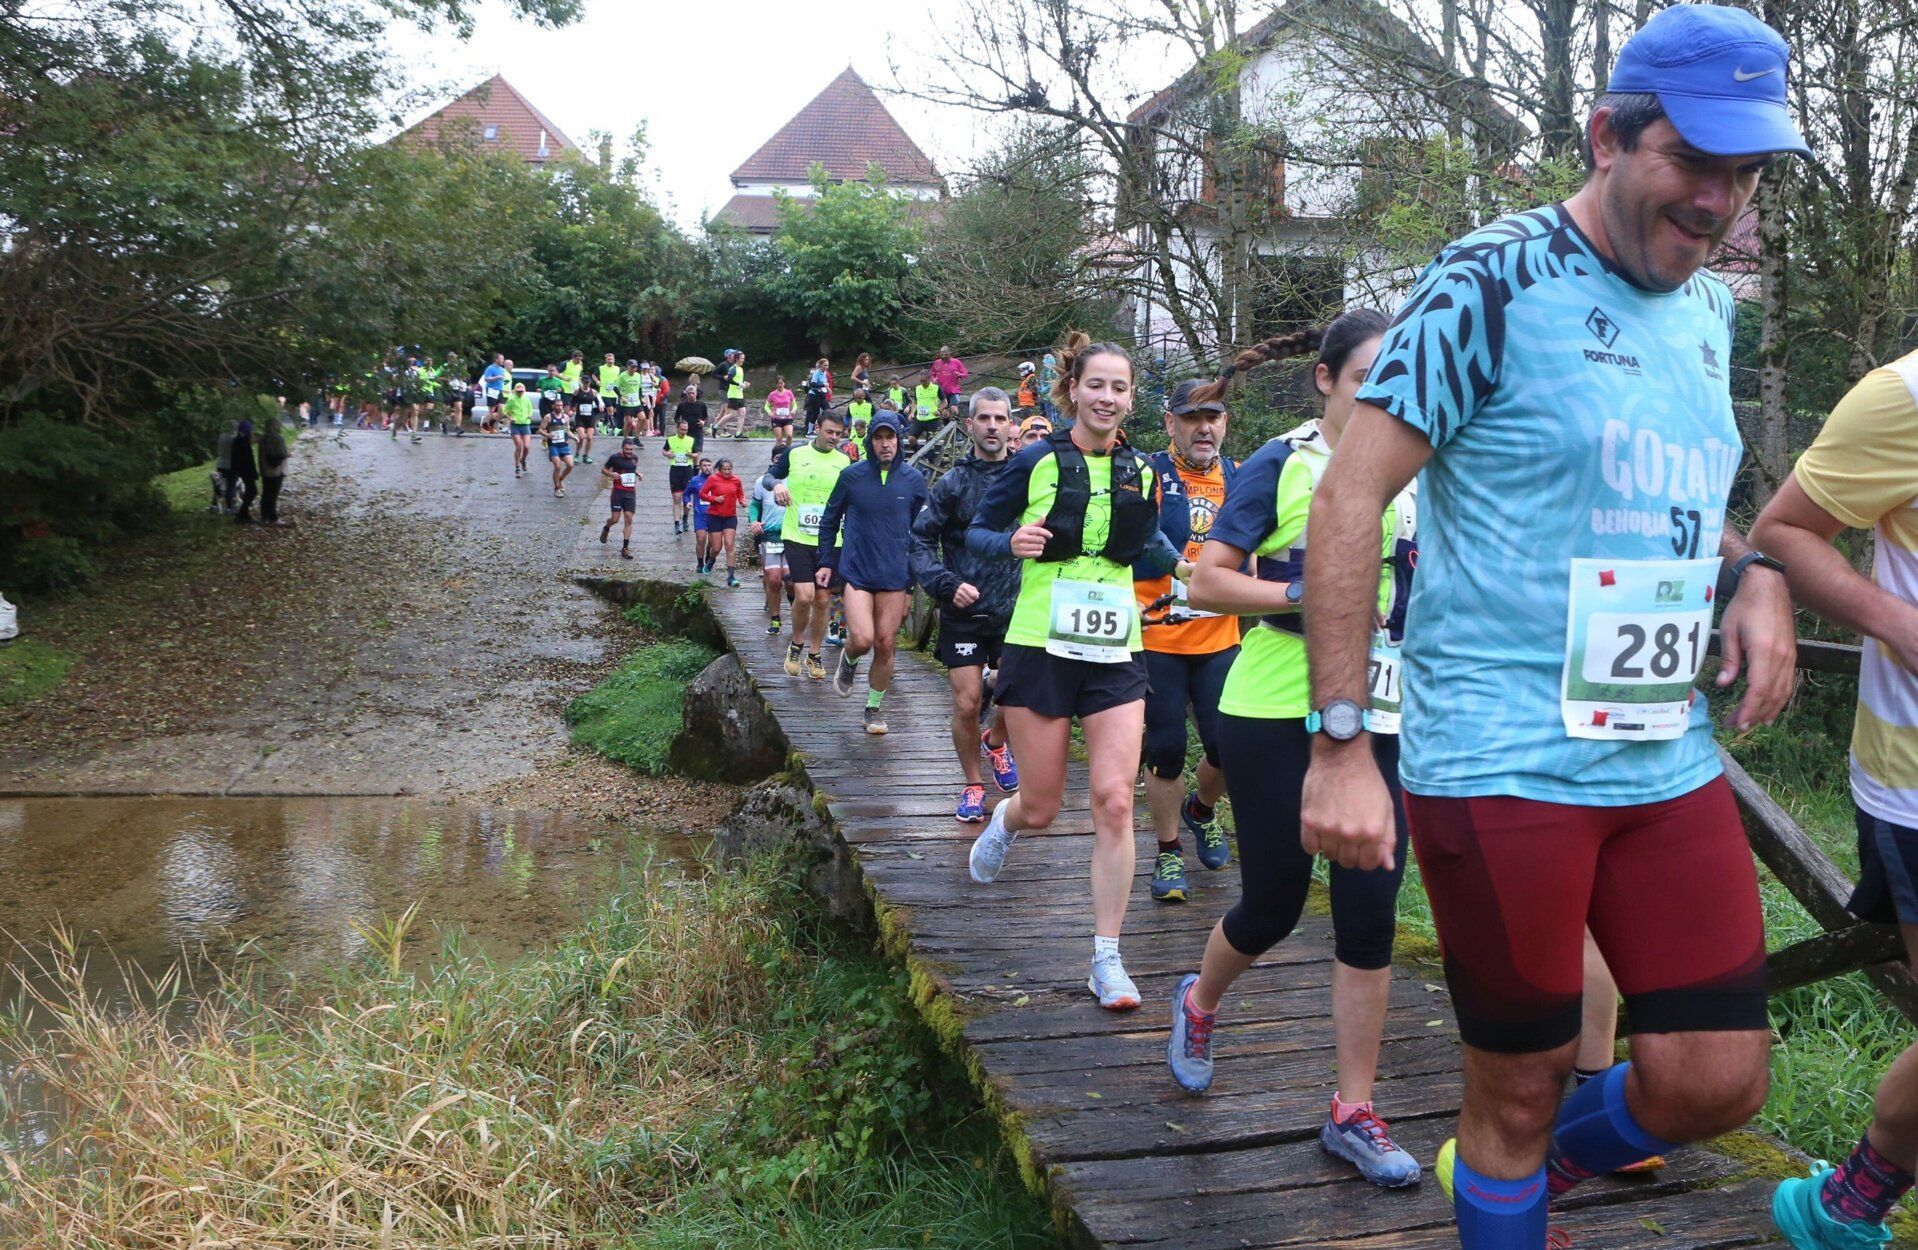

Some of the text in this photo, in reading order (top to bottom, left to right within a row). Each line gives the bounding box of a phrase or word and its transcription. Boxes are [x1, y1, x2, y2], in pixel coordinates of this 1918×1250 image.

[1583, 349, 1641, 368] FORTUNA
[1670, 506, 1701, 560] 57
[1071, 608, 1117, 635] 195
[1611, 621, 1700, 678] 281
